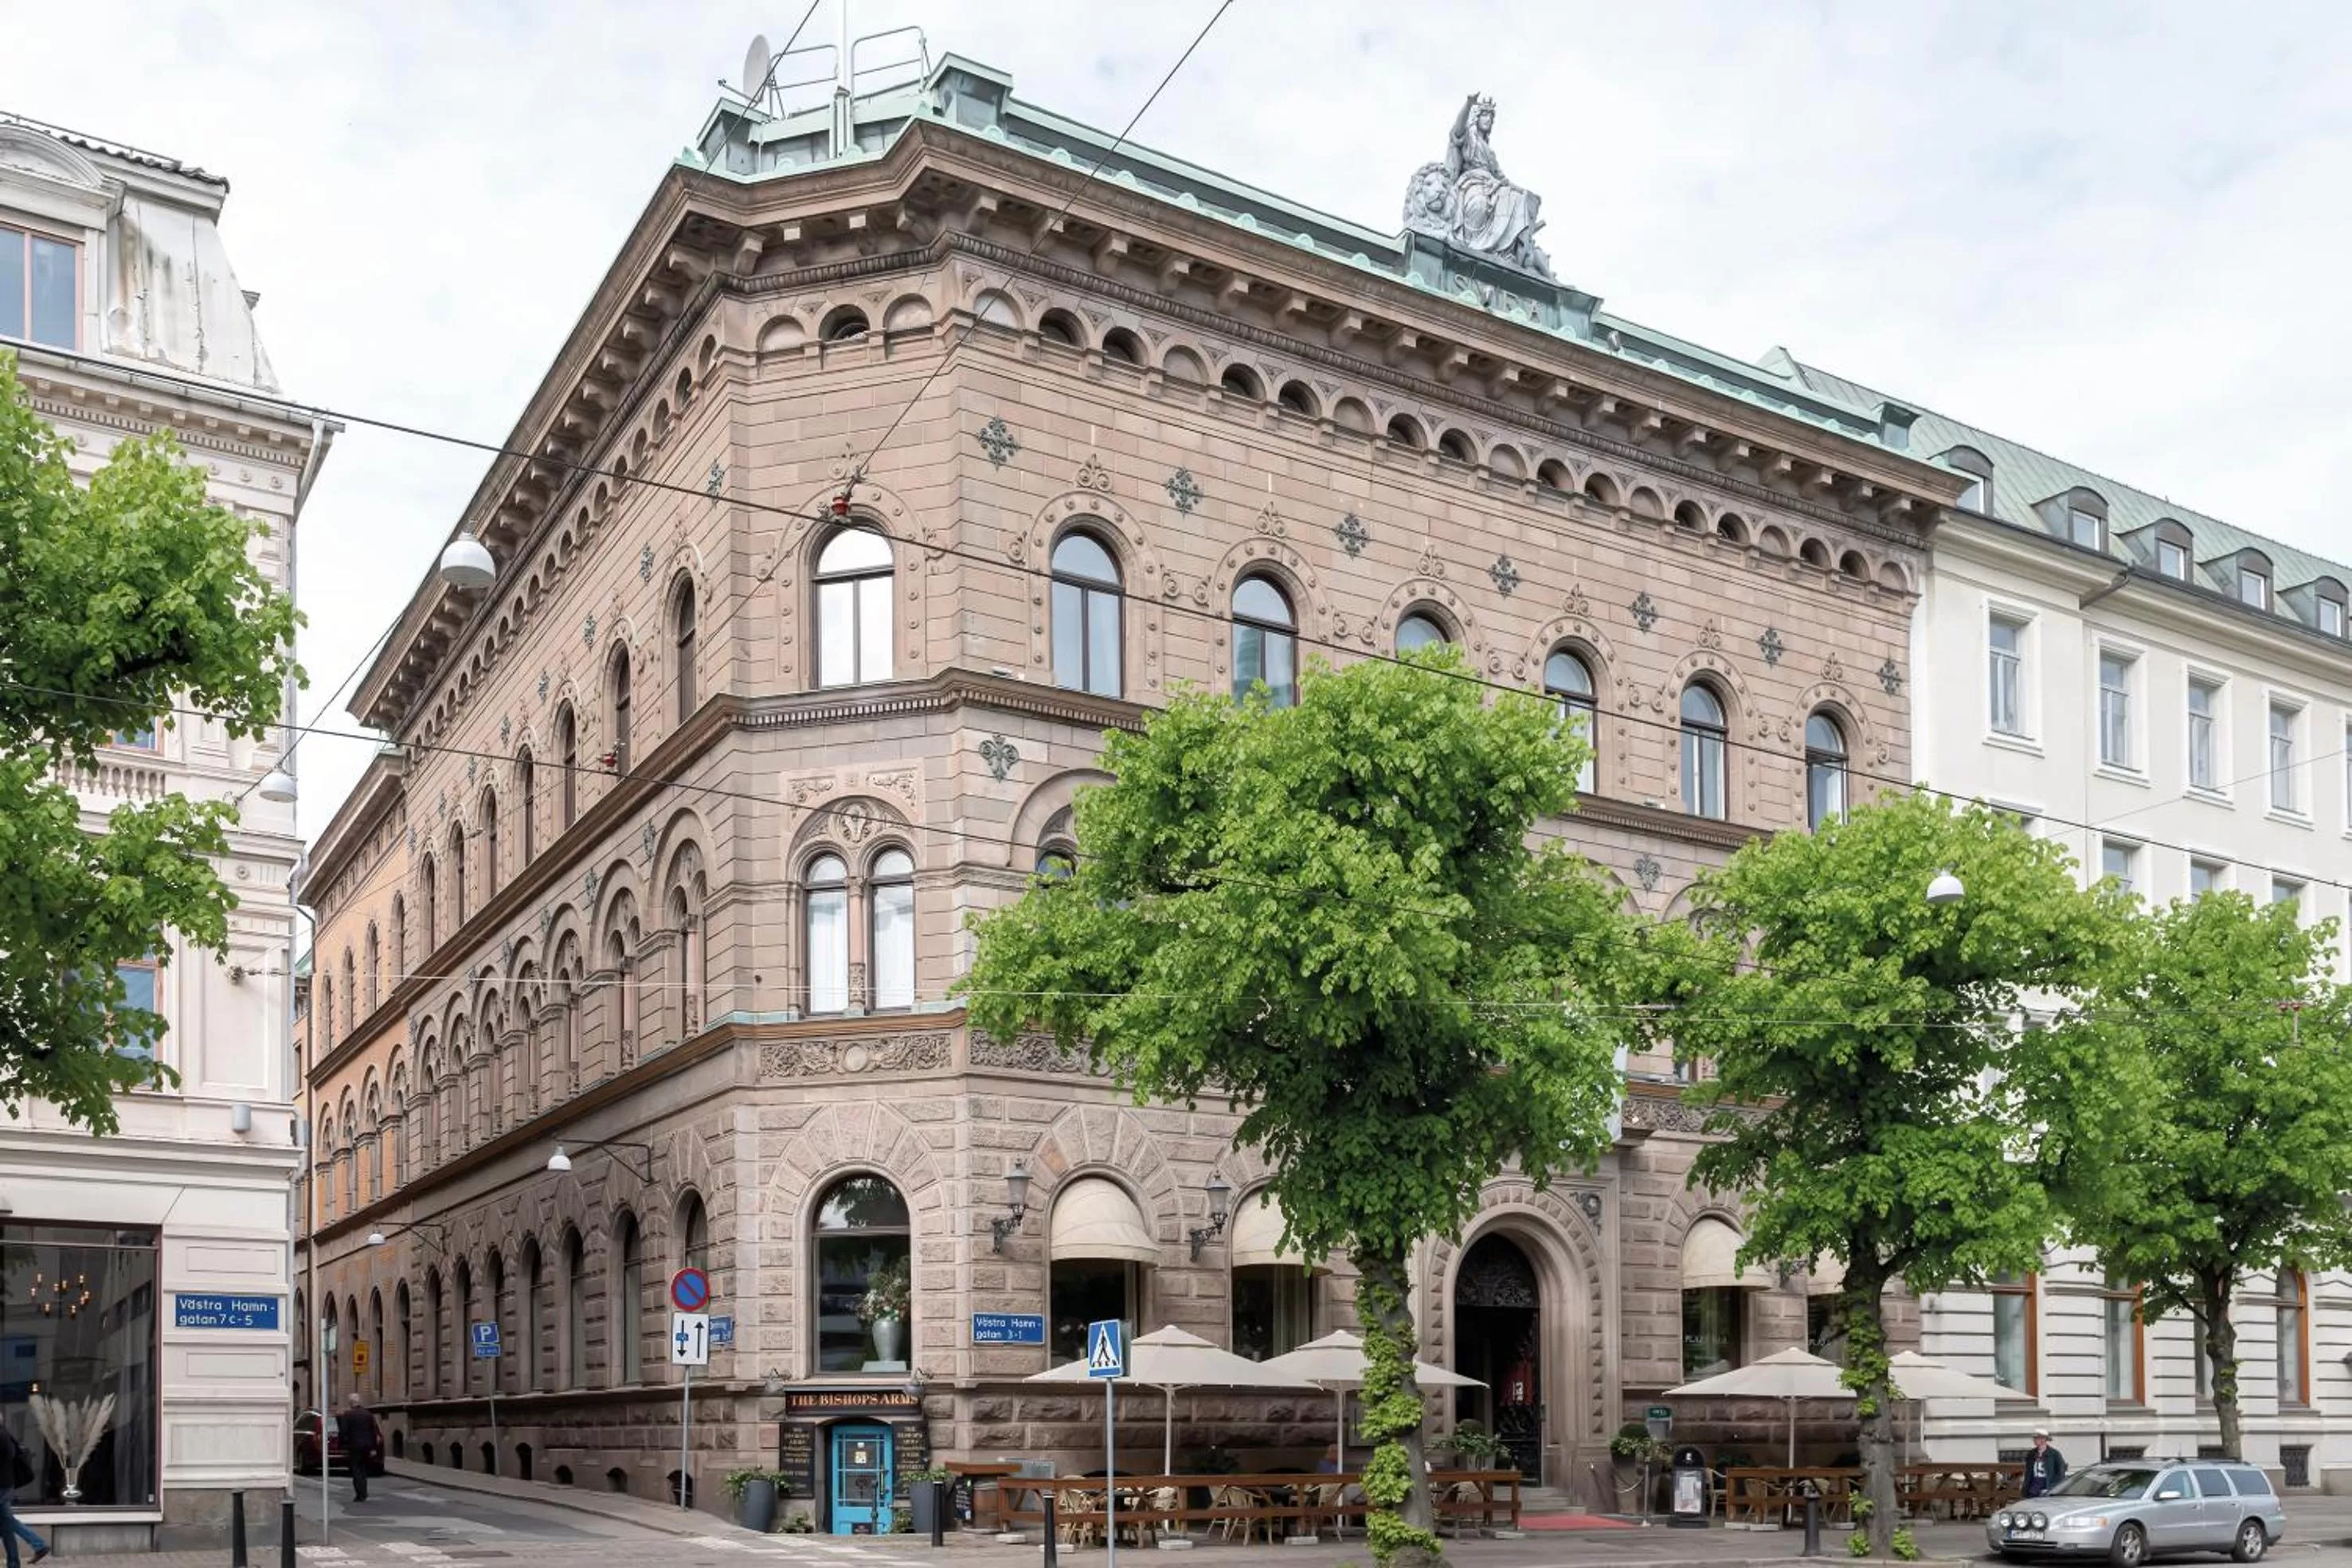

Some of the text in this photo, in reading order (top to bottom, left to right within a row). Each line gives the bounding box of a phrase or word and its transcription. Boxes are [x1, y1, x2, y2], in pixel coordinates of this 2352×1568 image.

[179, 1297, 222, 1310] Västra
[179, 1313, 217, 1326] gatan
[479, 1326, 491, 1342] P
[976, 1329, 1002, 1340] gatan
[791, 1394, 817, 1406] THE
[880, 1394, 918, 1406] ARMS
